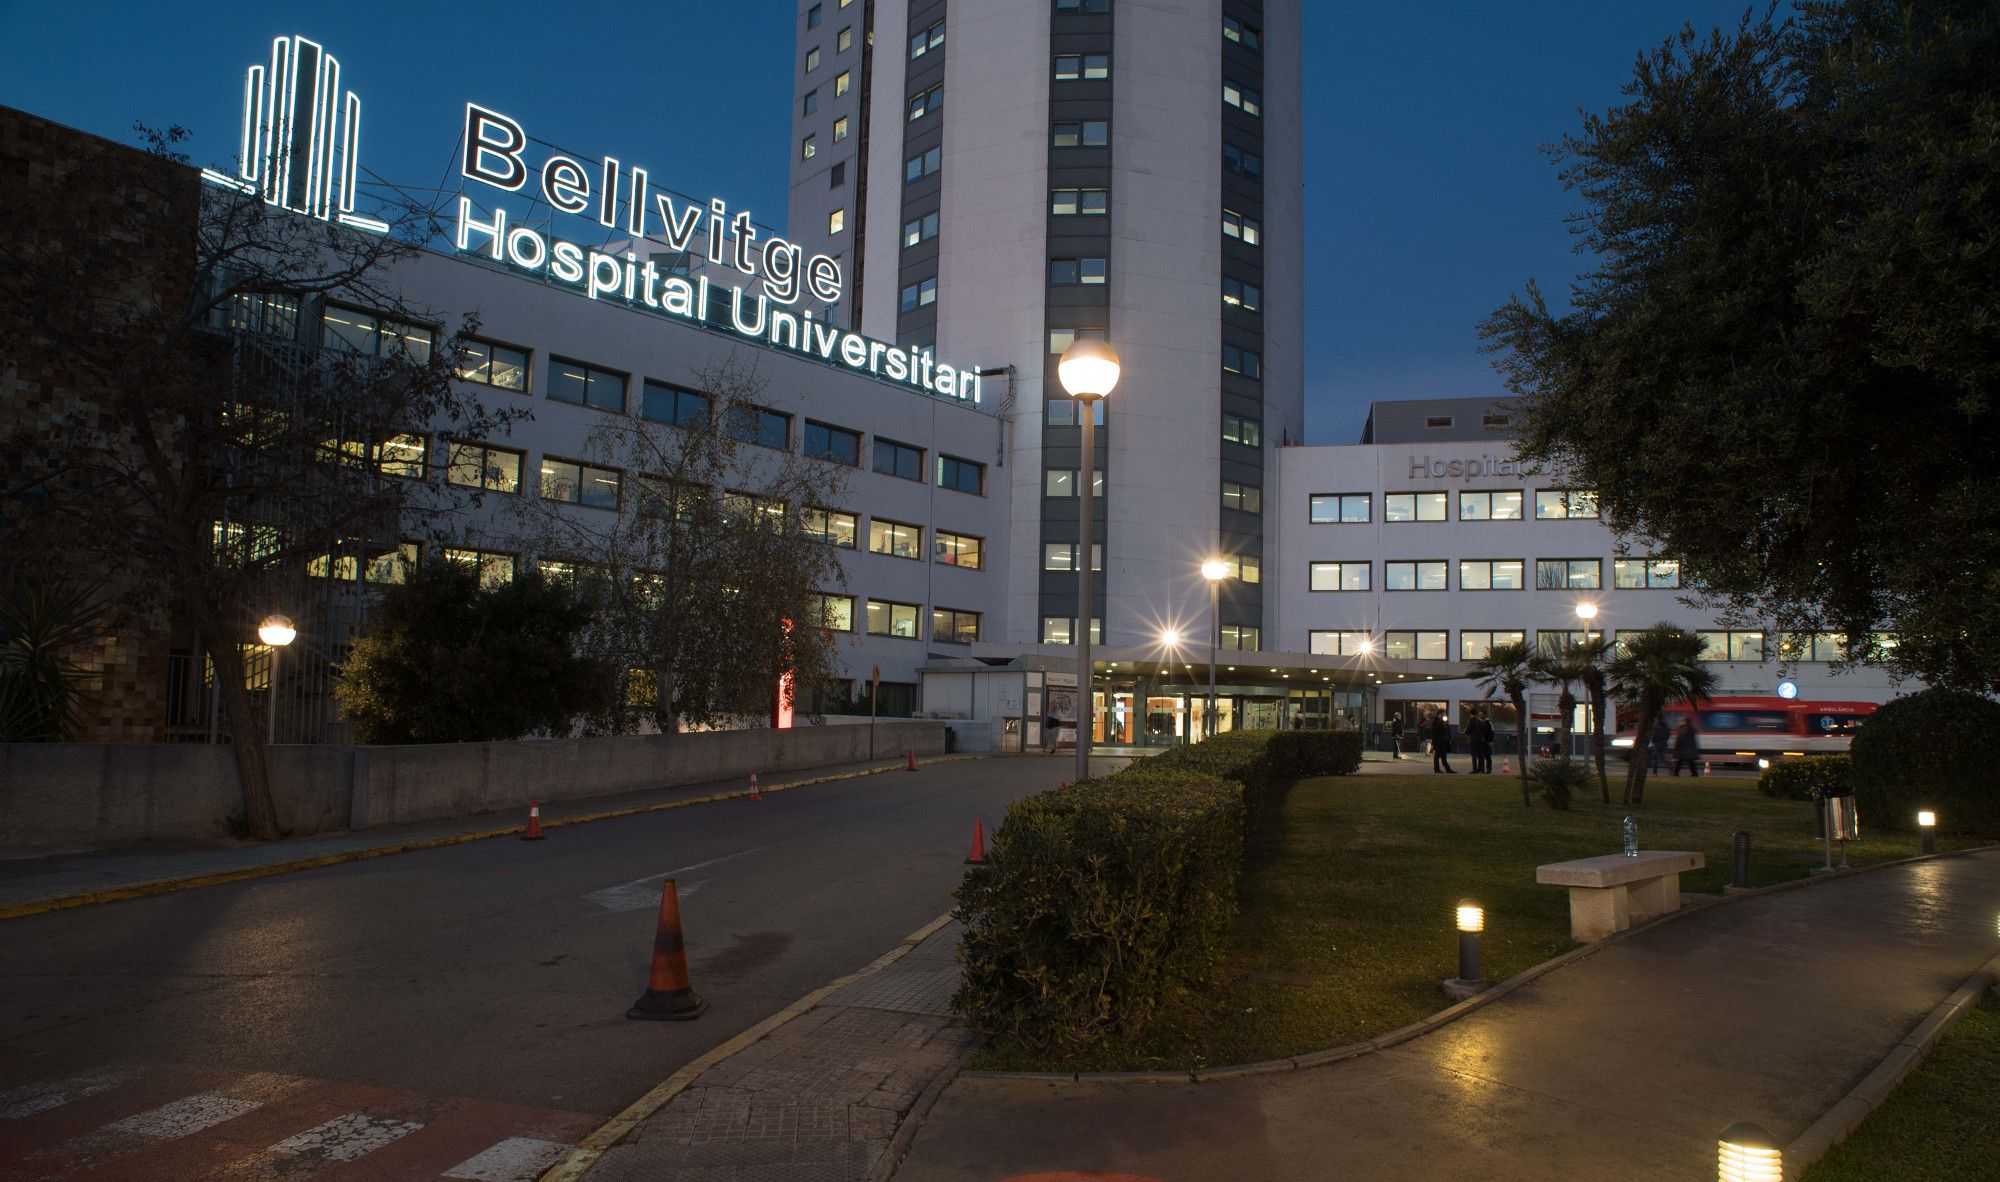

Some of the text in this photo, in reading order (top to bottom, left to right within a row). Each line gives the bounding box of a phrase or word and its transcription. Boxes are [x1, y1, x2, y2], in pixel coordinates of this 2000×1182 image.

[456, 196, 983, 404] Hospital Universitari
[461, 102, 843, 303] Bellvitge
[1782, 682, 1794, 698] 2
